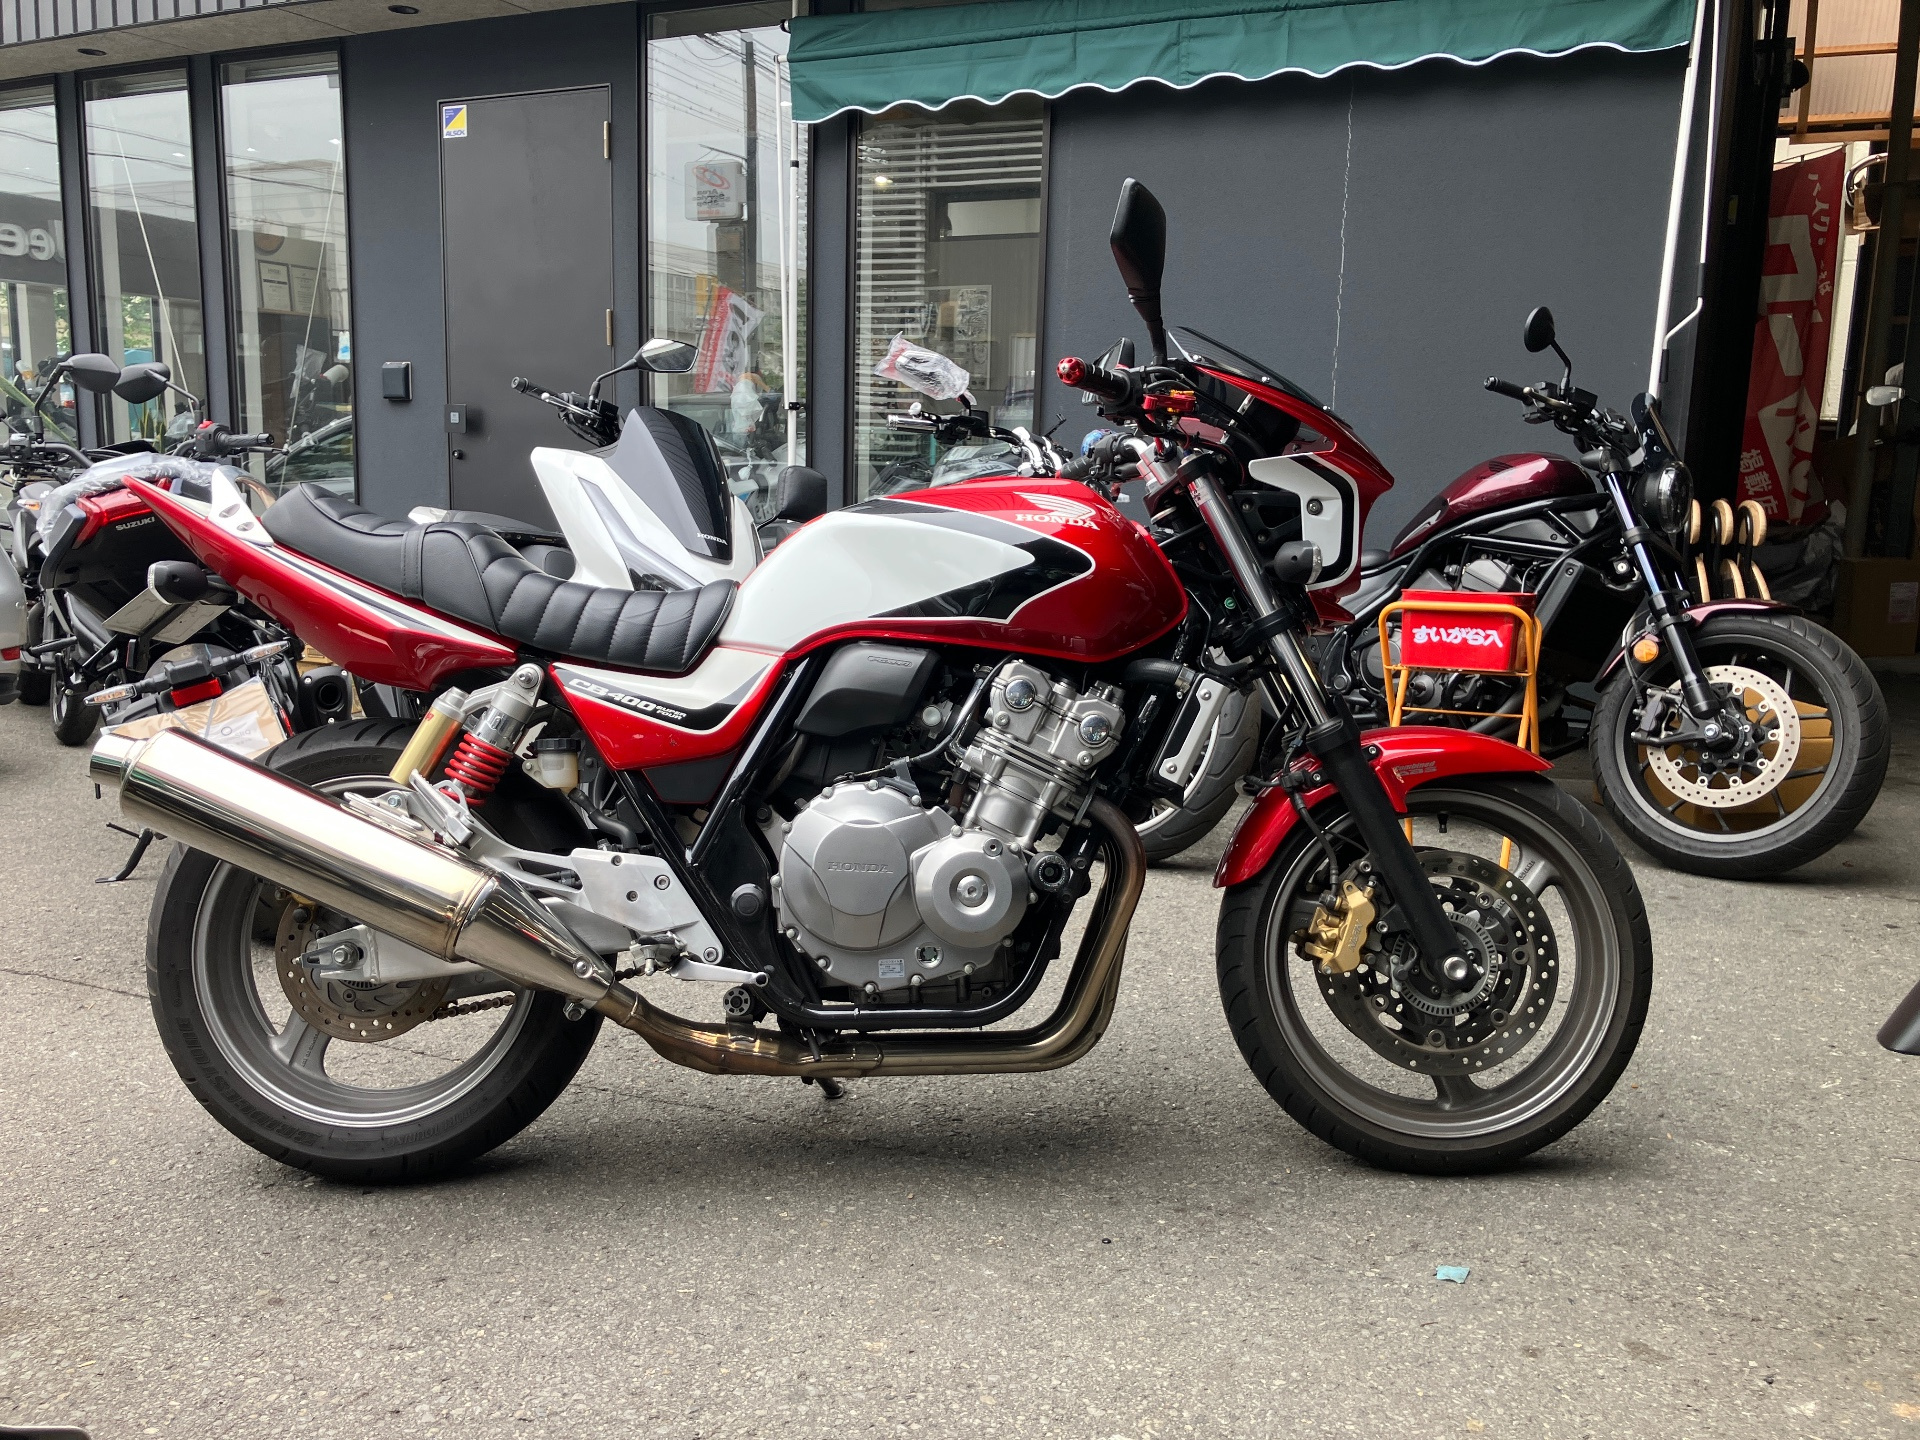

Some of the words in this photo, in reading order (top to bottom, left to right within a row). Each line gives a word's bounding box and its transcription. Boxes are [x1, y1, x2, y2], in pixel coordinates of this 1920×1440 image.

[445, 129, 466, 137] ALSOK
[115, 516, 156, 531] SUZUKI
[1015, 513, 1101, 531] HONDA
[696, 532, 728, 546] HONDA
[1412, 625, 1503, 648] すいがら入
[655, 705, 687, 718] SUPER
[656, 709, 683, 720] FOUR
[828, 861, 894, 874] HONDA
